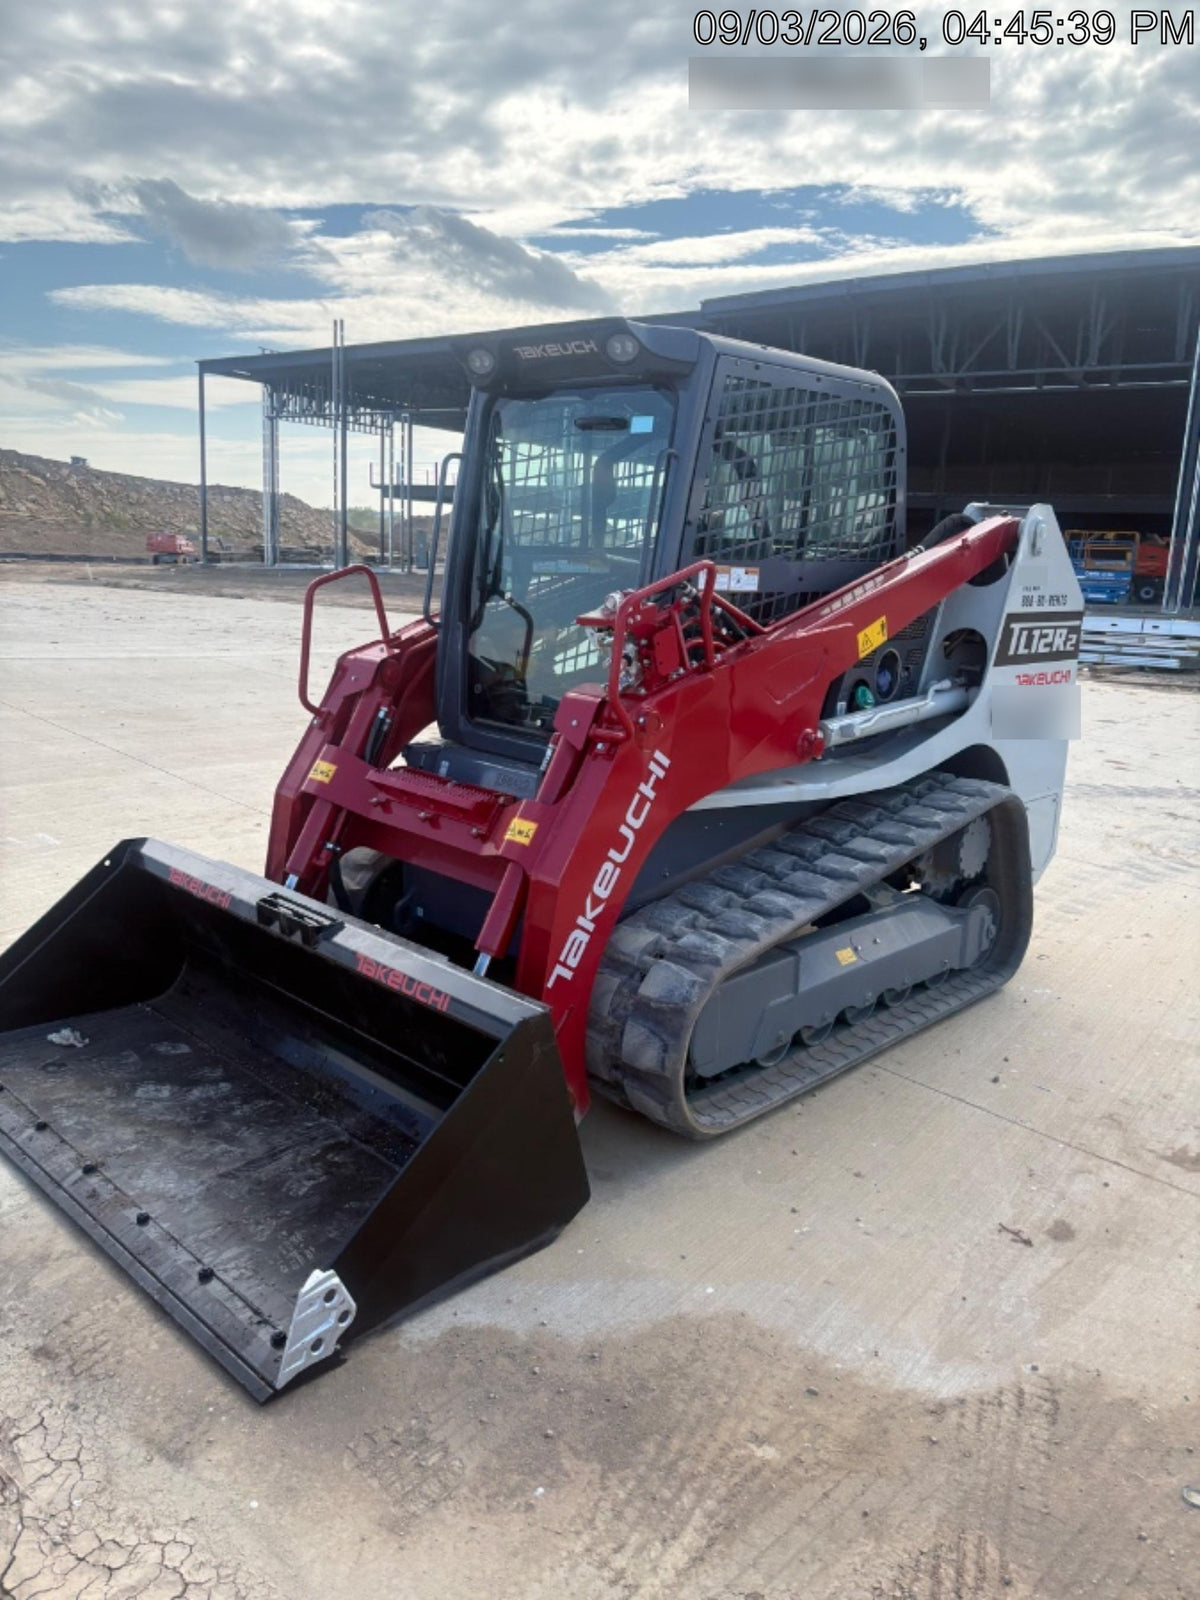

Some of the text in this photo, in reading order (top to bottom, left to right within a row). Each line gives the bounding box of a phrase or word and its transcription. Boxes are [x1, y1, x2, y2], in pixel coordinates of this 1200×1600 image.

[512, 340, 598, 360] TAKEUCH
[1008, 620, 1081, 656] TL12R2
[1015, 669, 1071, 686] TAKEUCHI
[168, 866, 232, 909] TAKEUCHI
[547, 750, 671, 988] TAKEUCHI
[355, 952, 450, 1013] TAKEUCHI
